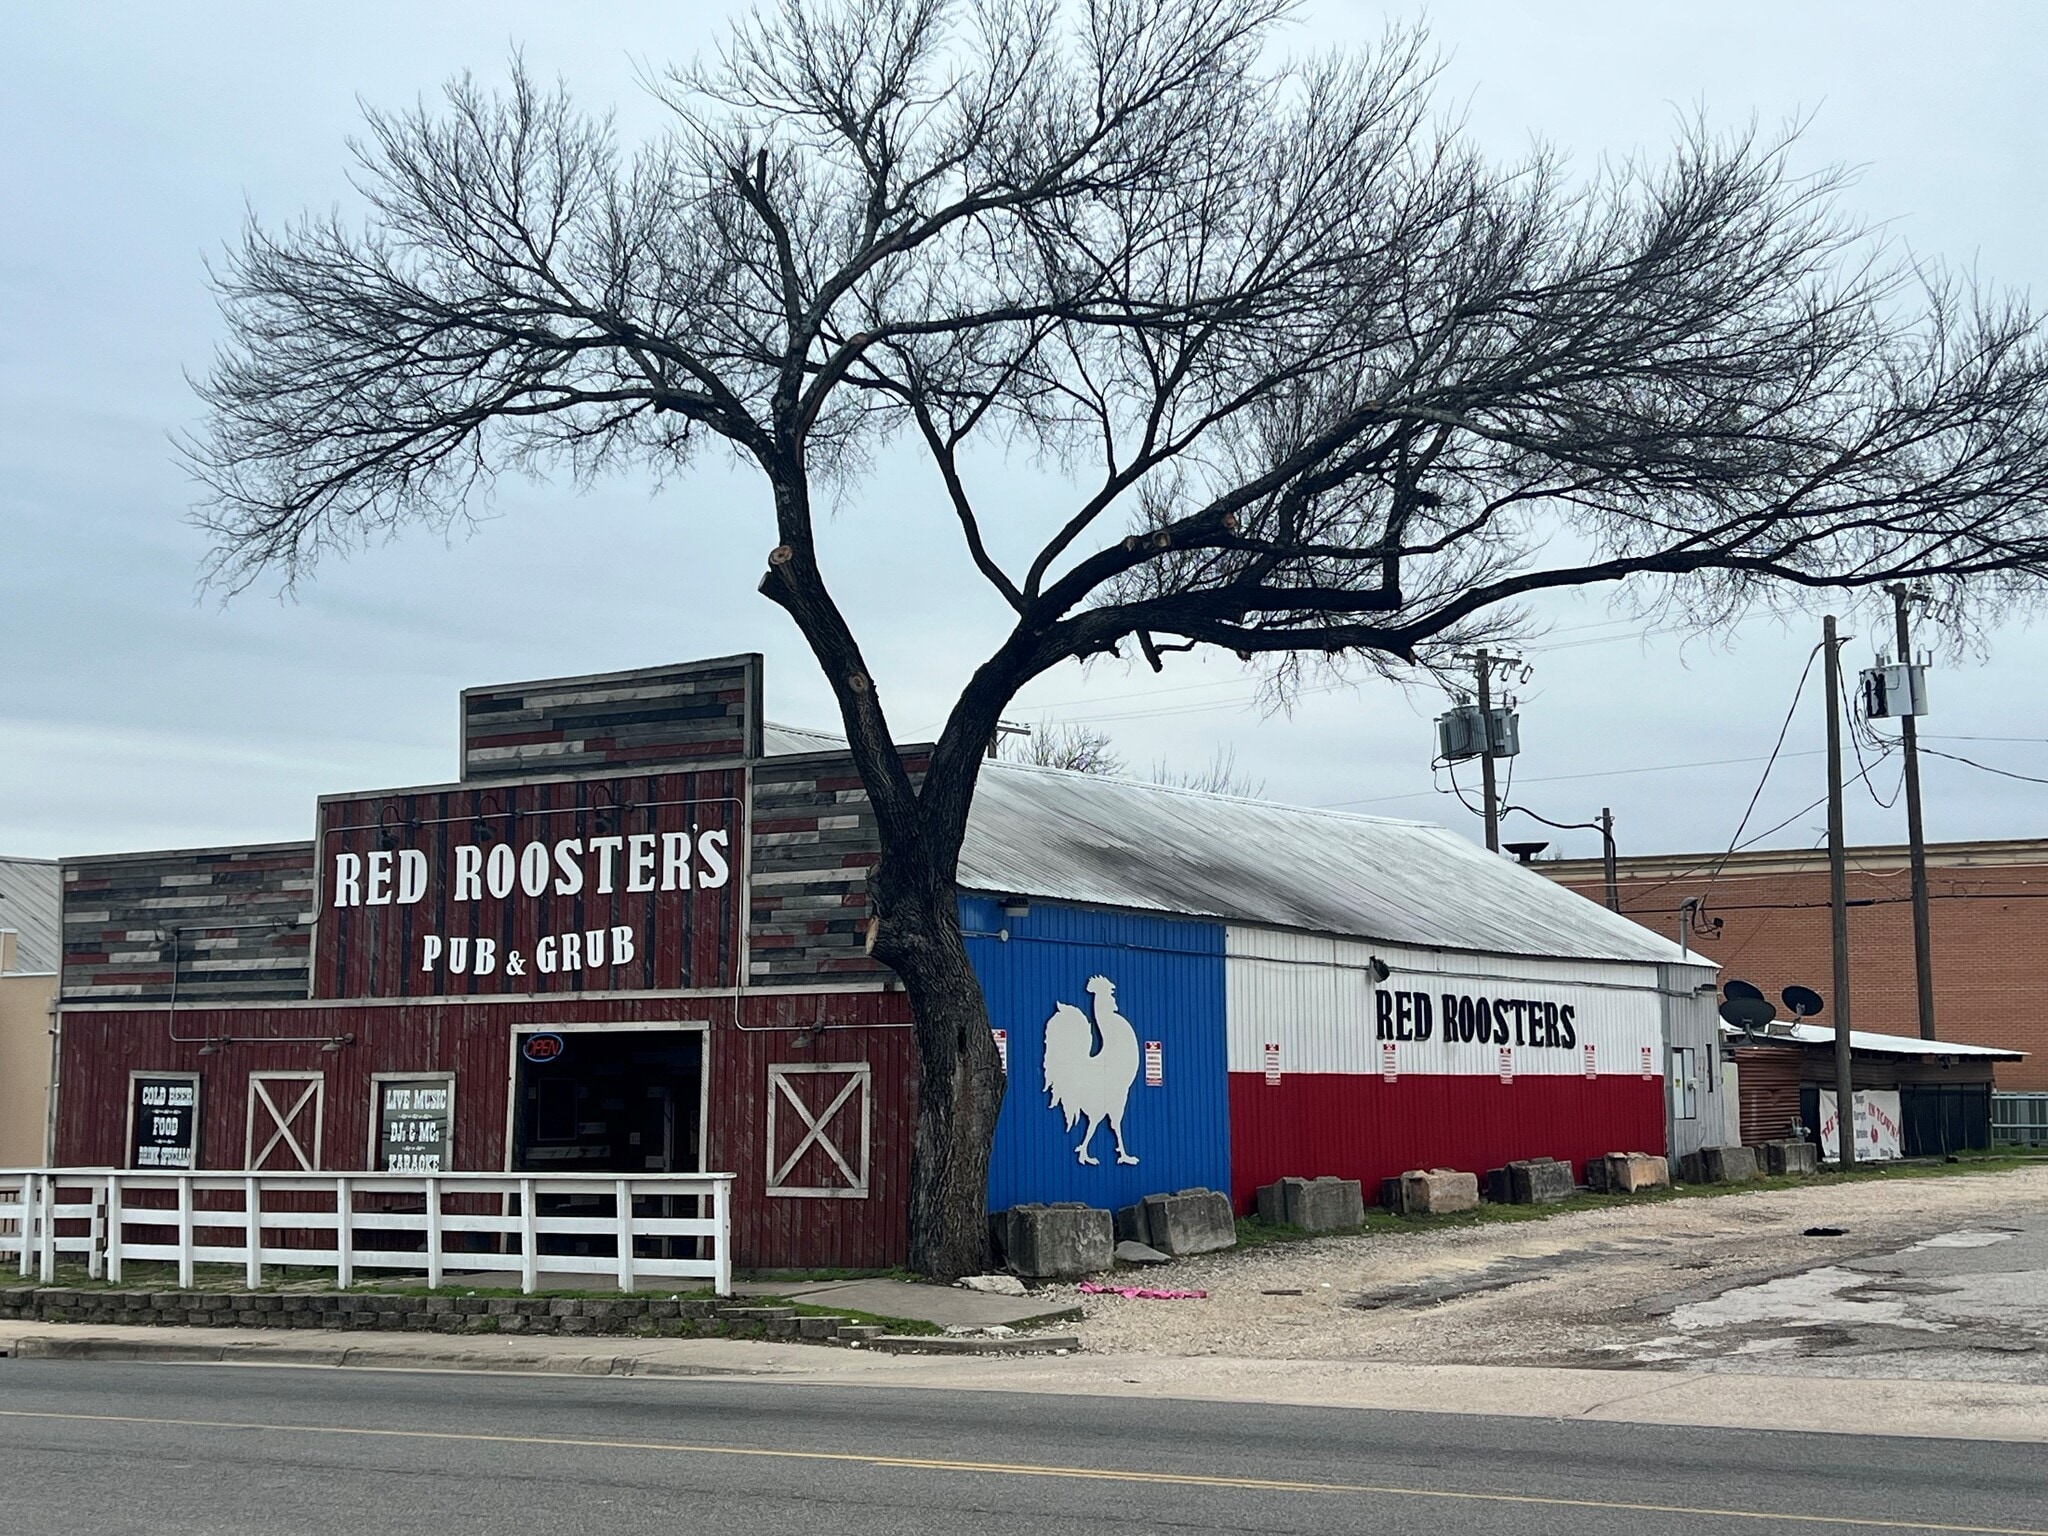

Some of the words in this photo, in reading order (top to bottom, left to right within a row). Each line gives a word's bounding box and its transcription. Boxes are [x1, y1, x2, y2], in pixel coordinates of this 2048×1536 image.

[333, 848, 429, 908] RED
[453, 823, 731, 902] ROOSTER'S
[421, 934, 497, 976] PUB
[506, 950, 526, 976] &
[535, 925, 636, 974] GRUB
[1375, 989, 1433, 1042] RED
[1441, 993, 1577, 1050] ROOSTERS
[526, 1038, 560, 1057] OPEN
[142, 1086, 166, 1106] COLD
[167, 1087, 194, 1107] BEER
[386, 1089, 411, 1110] LIVE
[413, 1089, 447, 1110] MUSIC
[152, 1116, 179, 1136] FOOD
[409, 1121, 417, 1142] &
[388, 1154, 440, 1174] KARAOKE
